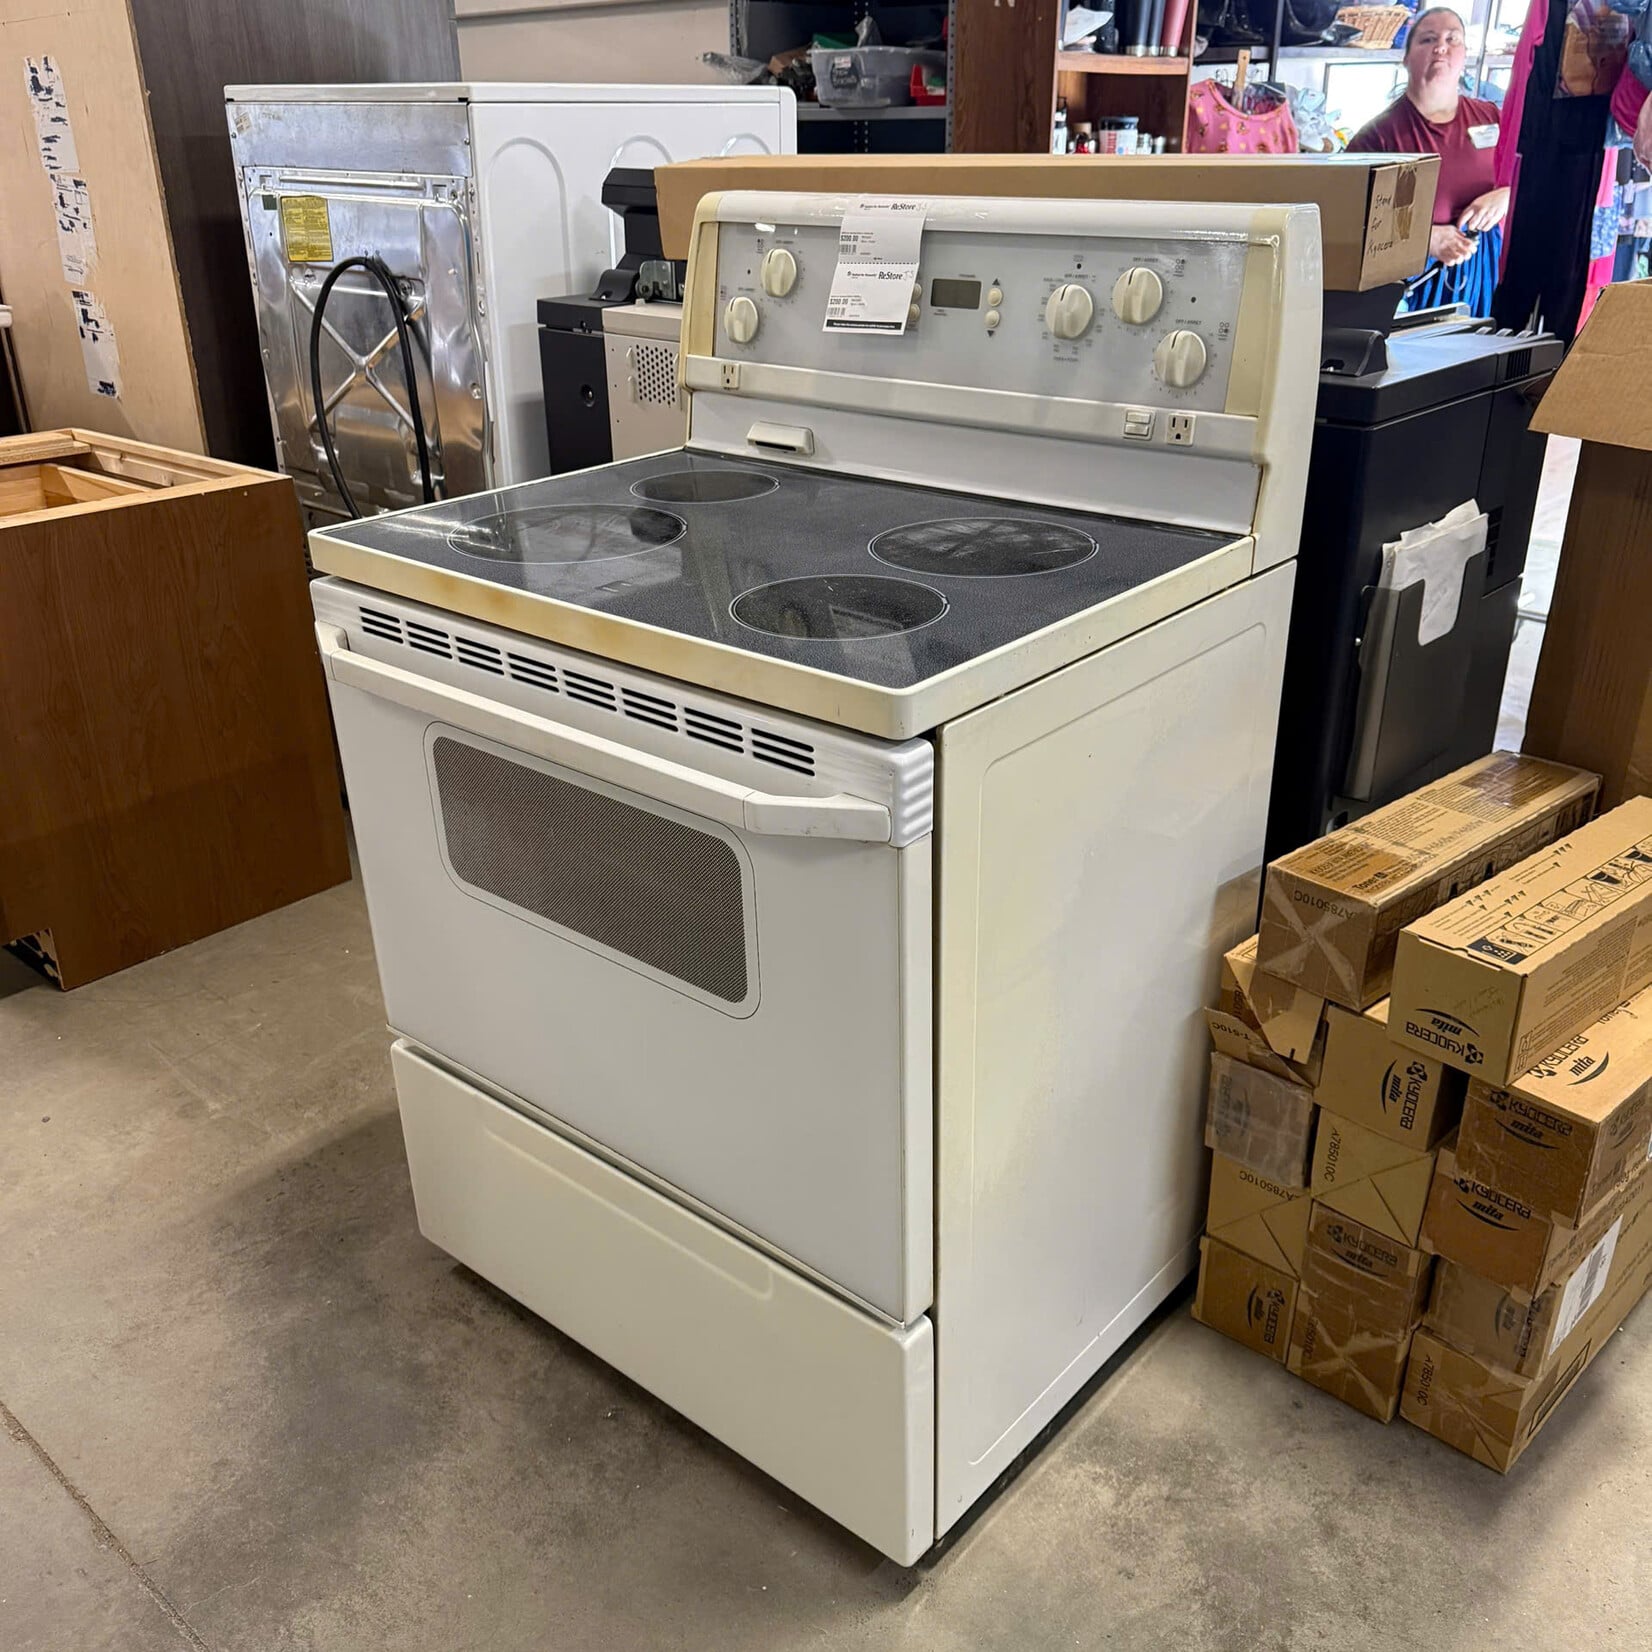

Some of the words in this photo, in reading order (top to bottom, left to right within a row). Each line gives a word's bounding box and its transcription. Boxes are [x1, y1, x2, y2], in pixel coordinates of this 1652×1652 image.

[891, 203, 916, 211] ReStore
[878, 271, 904, 280] ReStore
[1405, 1021, 1465, 1057] KYOCERA
[1431, 1017, 1463, 1037] mita
[1539, 1034, 1590, 1071] KYOCERA
[1569, 1055, 1597, 1077] mita
[1389, 1074, 1402, 1104] mita
[1400, 1075, 1423, 1131] KYOCERA
[1509, 1097, 1574, 1137] KYOCERA
[1510, 1119, 1545, 1139] mita
[1324, 1127, 1342, 1183] A785010C
[1239, 1170, 1296, 1201] A785010C
[1471, 1181, 1532, 1220] KYOCERA
[1472, 1200, 1505, 1221] mita
[1343, 1232, 1399, 1268] KYOCERA
[1263, 1300, 1281, 1345] KYOCERA
